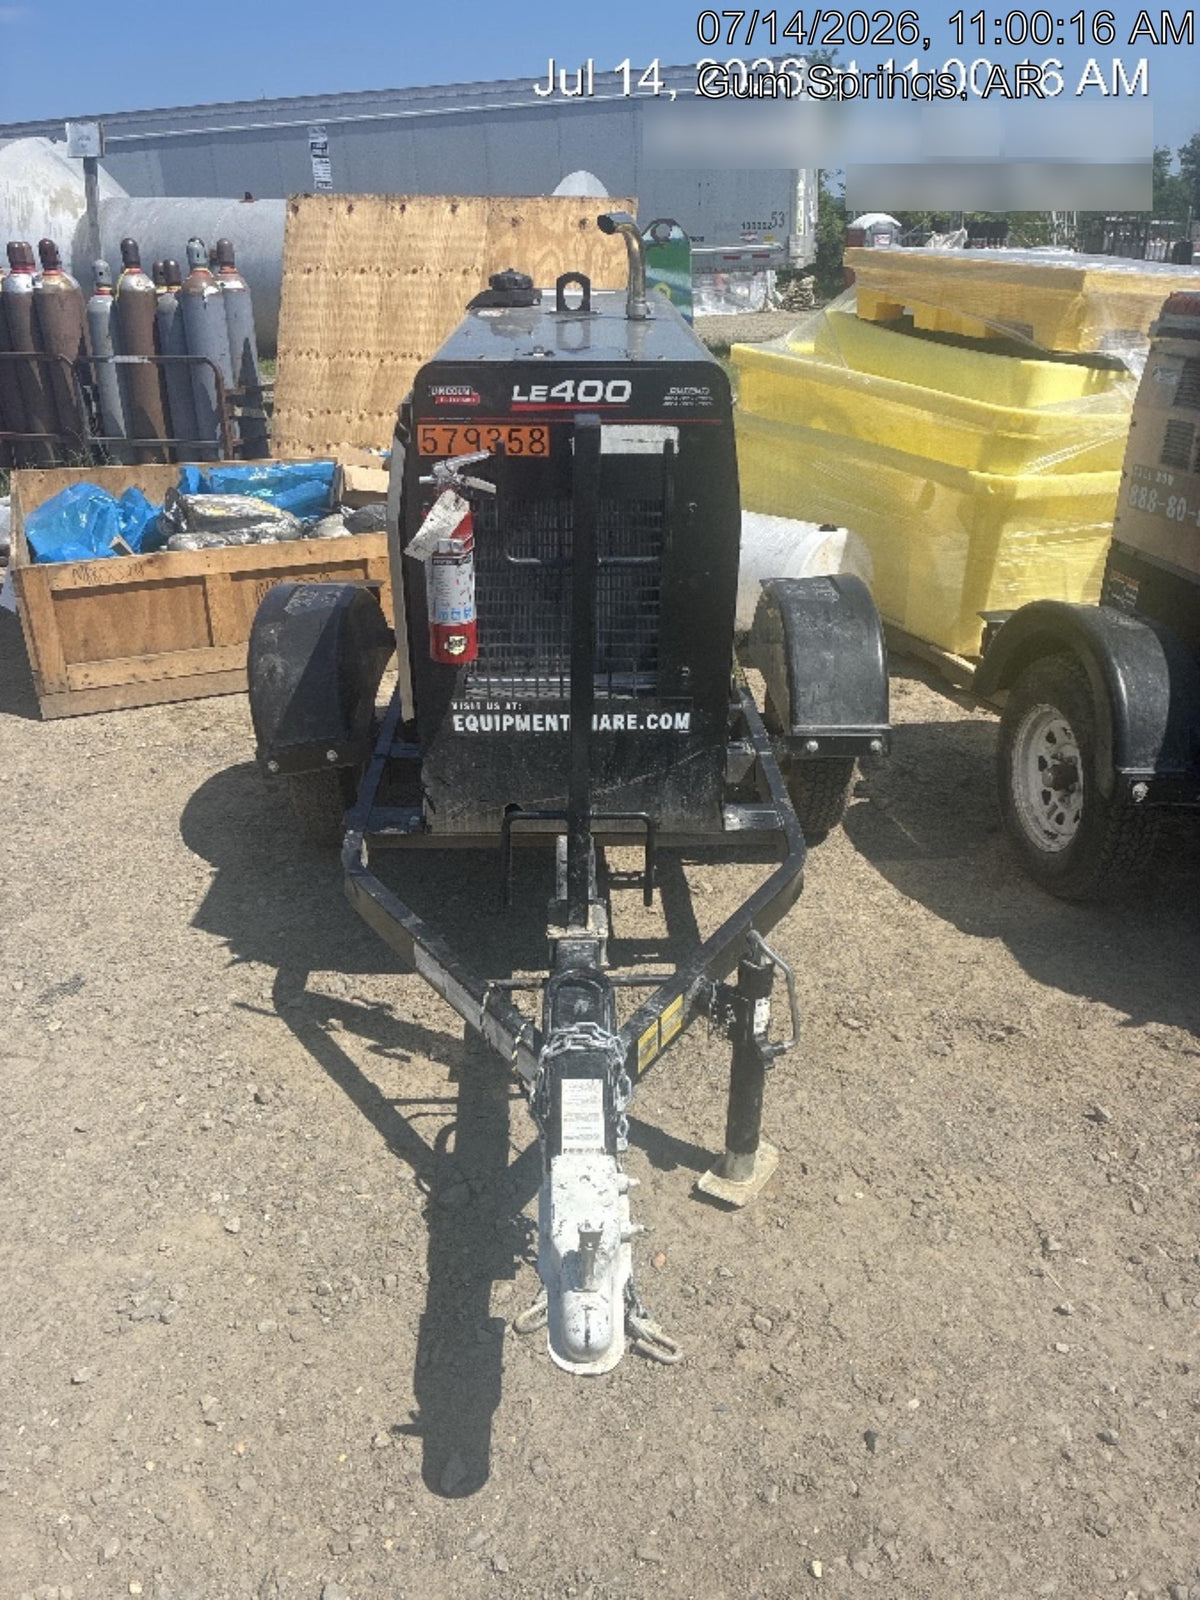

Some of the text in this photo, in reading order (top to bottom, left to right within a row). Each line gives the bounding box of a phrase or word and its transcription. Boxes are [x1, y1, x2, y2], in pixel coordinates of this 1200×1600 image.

[512, 380, 633, 403] LE400
[421, 427, 546, 455] 579358
[450, 701, 523, 711] VISIT US AT:
